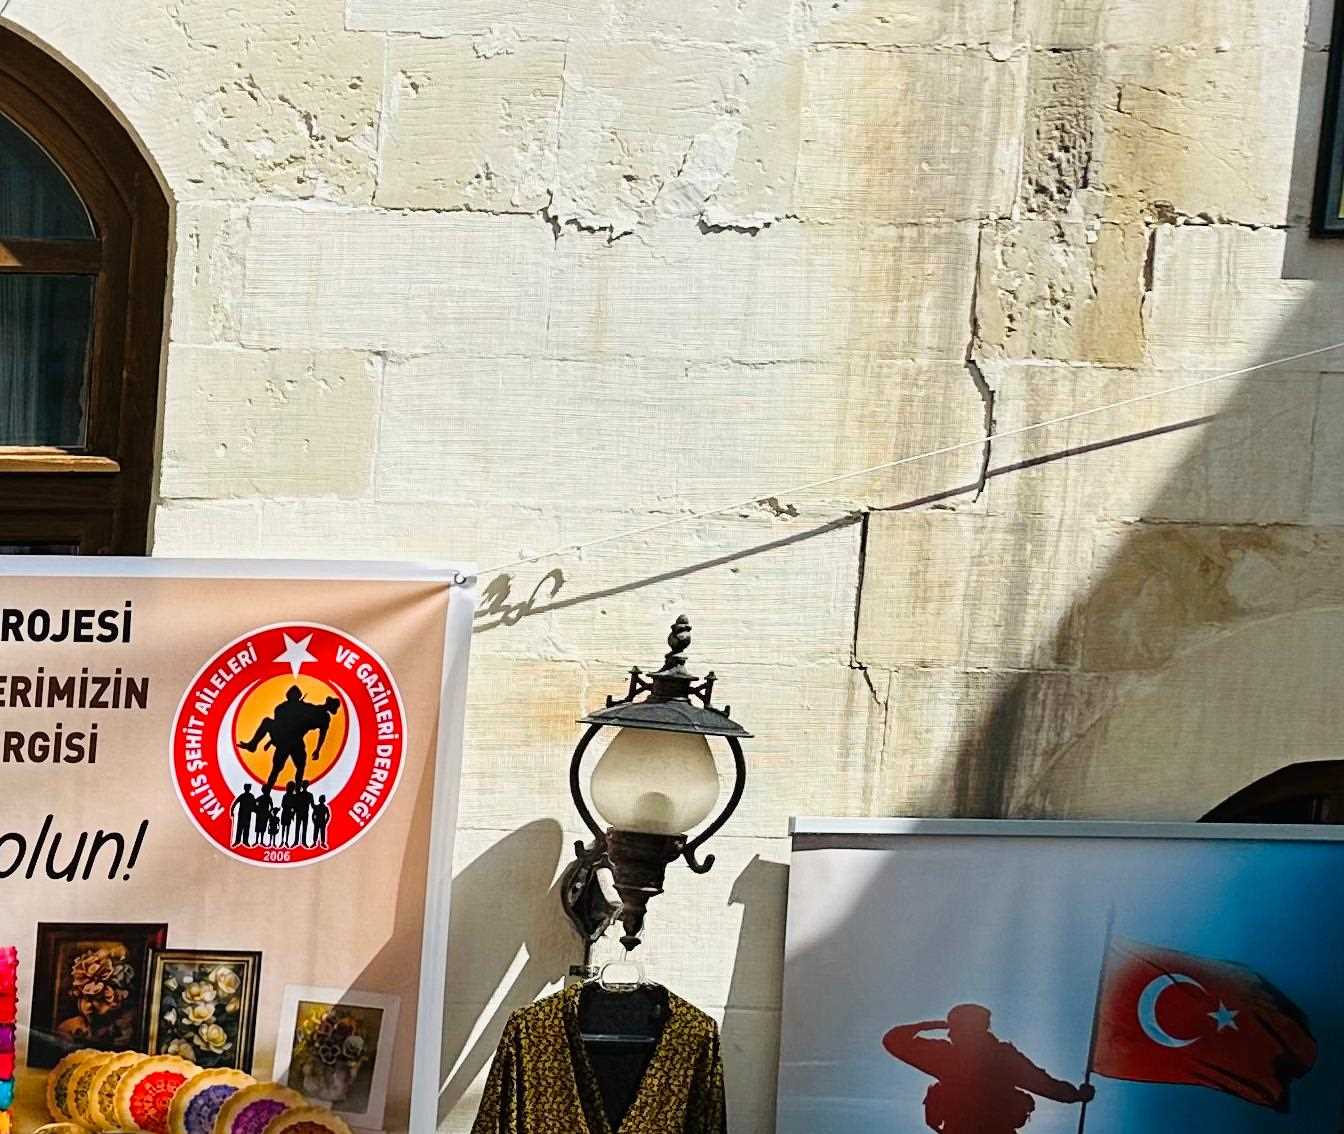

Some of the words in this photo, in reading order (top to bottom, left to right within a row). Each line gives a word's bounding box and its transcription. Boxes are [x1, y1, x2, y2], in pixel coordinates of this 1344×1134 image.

[194, 641, 258, 715] AİLELERİ
[335, 645, 359, 670] VE
[356, 662, 400, 740] GAZİLERİ
[182, 715, 208, 773] ŞEHİT
